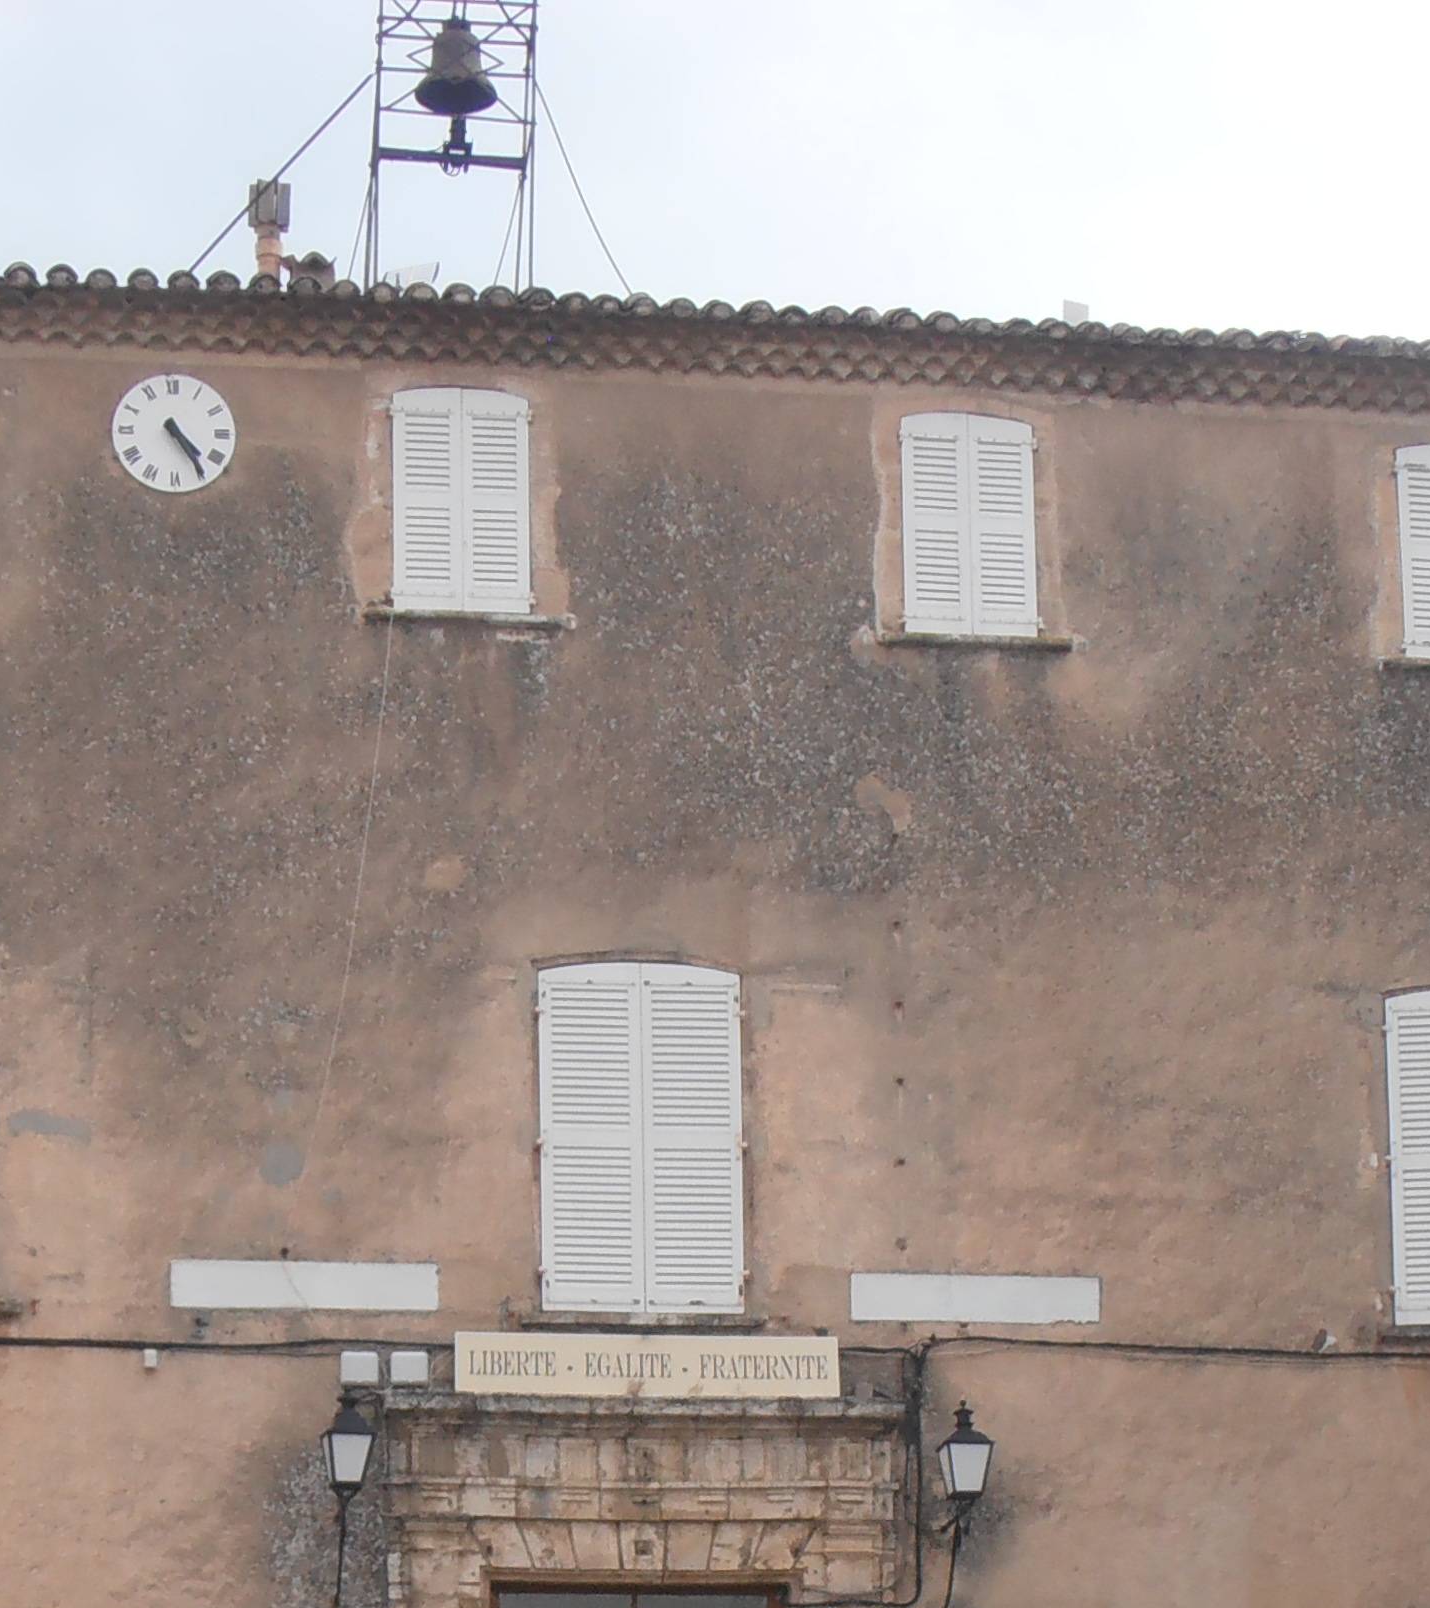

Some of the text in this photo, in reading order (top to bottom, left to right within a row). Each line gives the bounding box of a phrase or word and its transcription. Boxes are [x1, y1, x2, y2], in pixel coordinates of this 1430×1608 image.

[469, 1350, 828, 1380] LIBERTE EGALITE FRATERNITE
